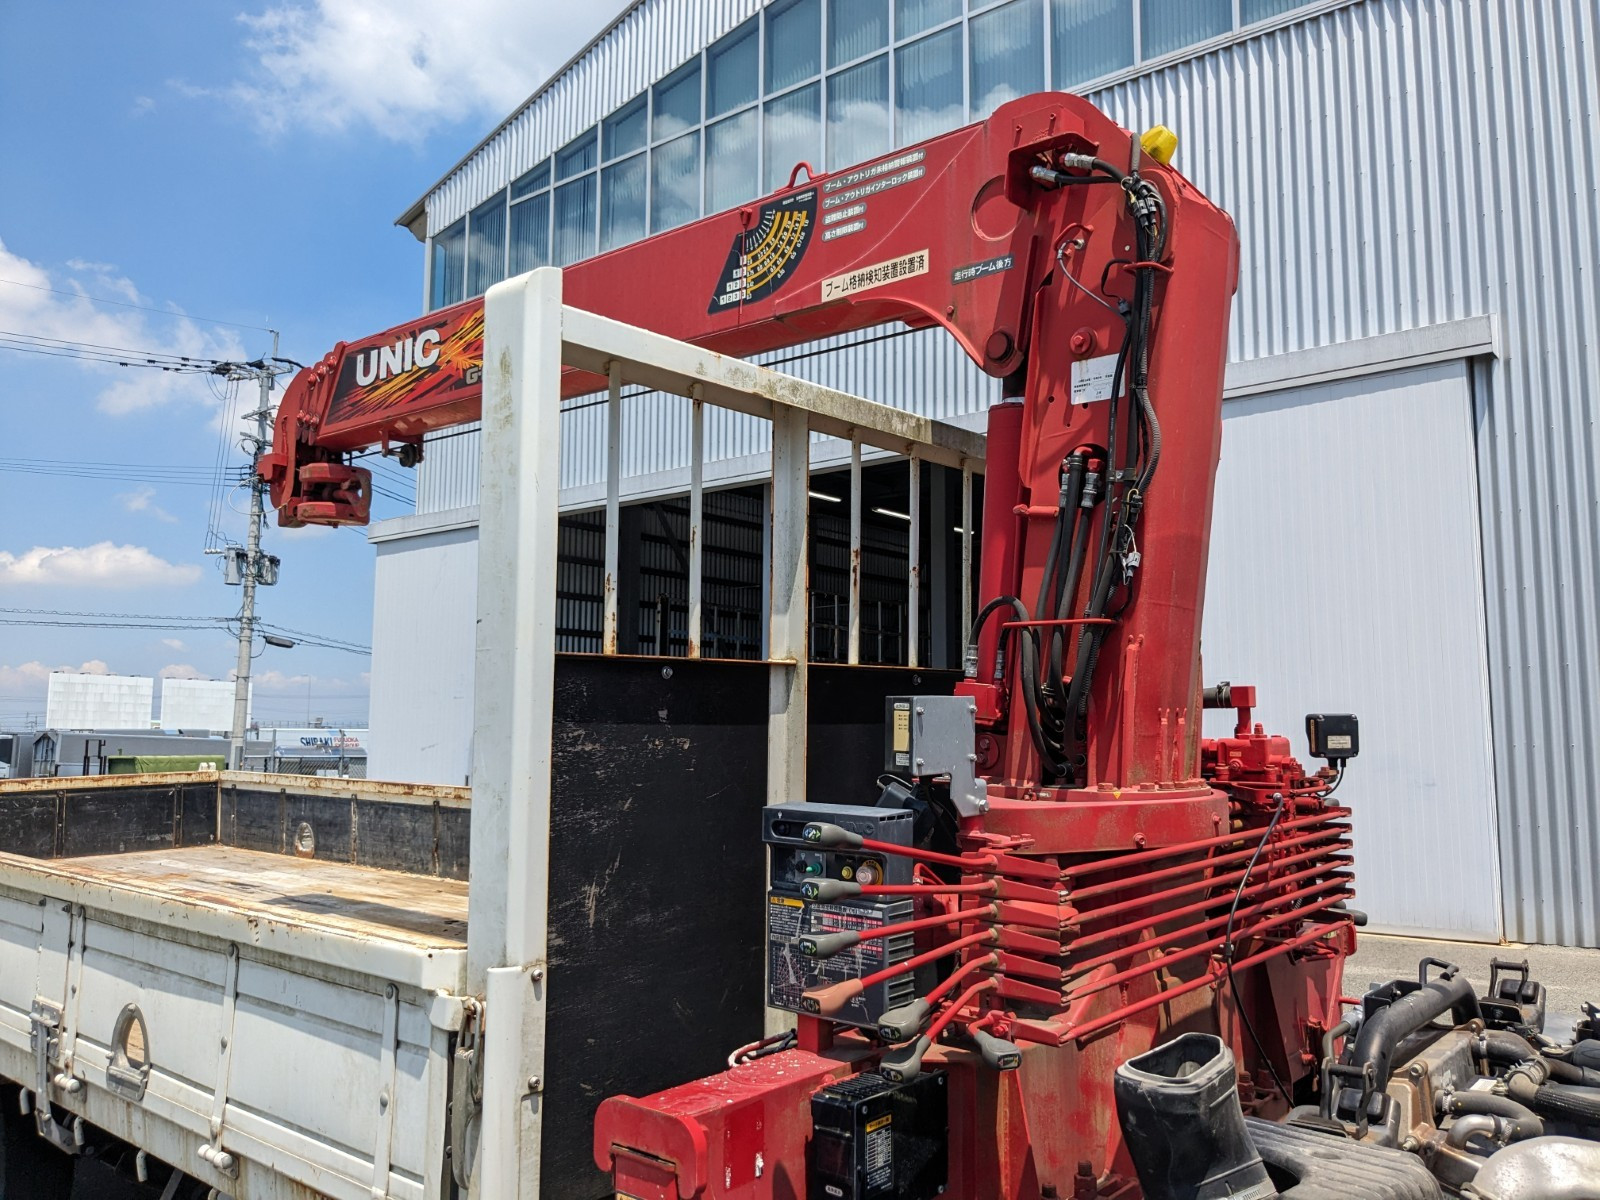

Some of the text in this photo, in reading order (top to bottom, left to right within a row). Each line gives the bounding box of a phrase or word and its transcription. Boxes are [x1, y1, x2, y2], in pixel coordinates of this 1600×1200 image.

[825, 254, 925, 298] ブーム格納検知装置設置済
[954, 258, 1012, 282] 走行時ブーム後方
[356, 329, 441, 387] UNIC
